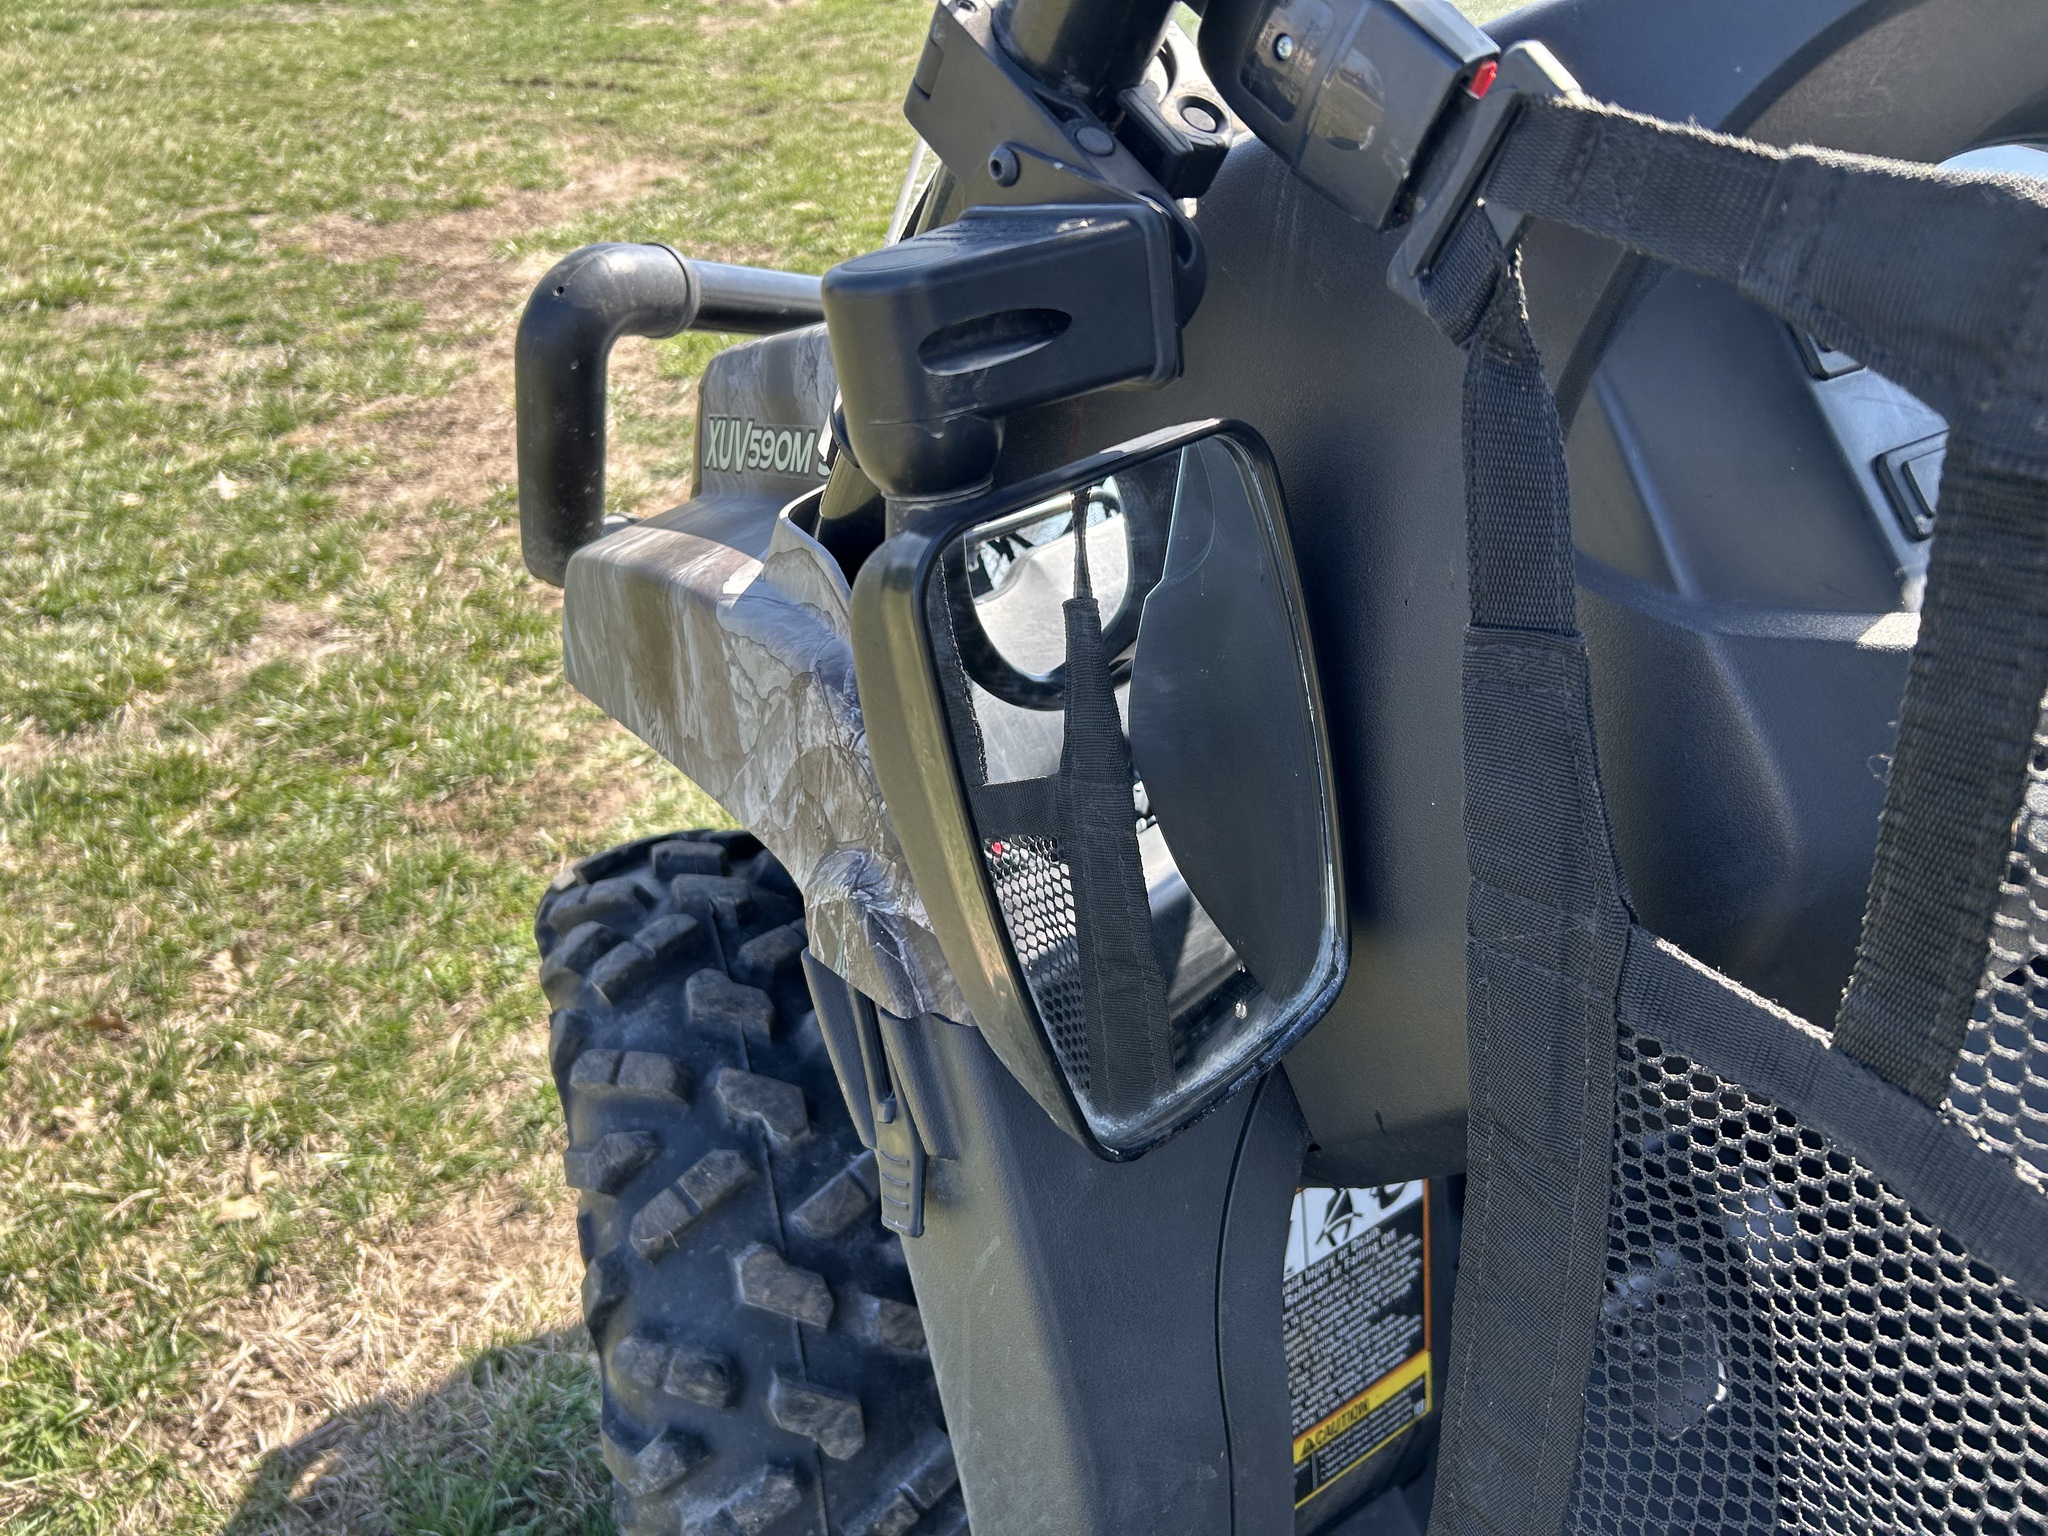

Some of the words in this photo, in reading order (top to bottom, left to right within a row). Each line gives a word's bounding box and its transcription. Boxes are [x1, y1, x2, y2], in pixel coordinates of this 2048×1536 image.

[705, 419, 815, 473] XUV590M
[1283, 1274, 1304, 1295] oid
[1305, 1255, 1335, 1283] Injury
[1351, 1225, 1382, 1252] Death
[1344, 1240, 1379, 1270] Falling
[1315, 1397, 1370, 1443] CAUTION
